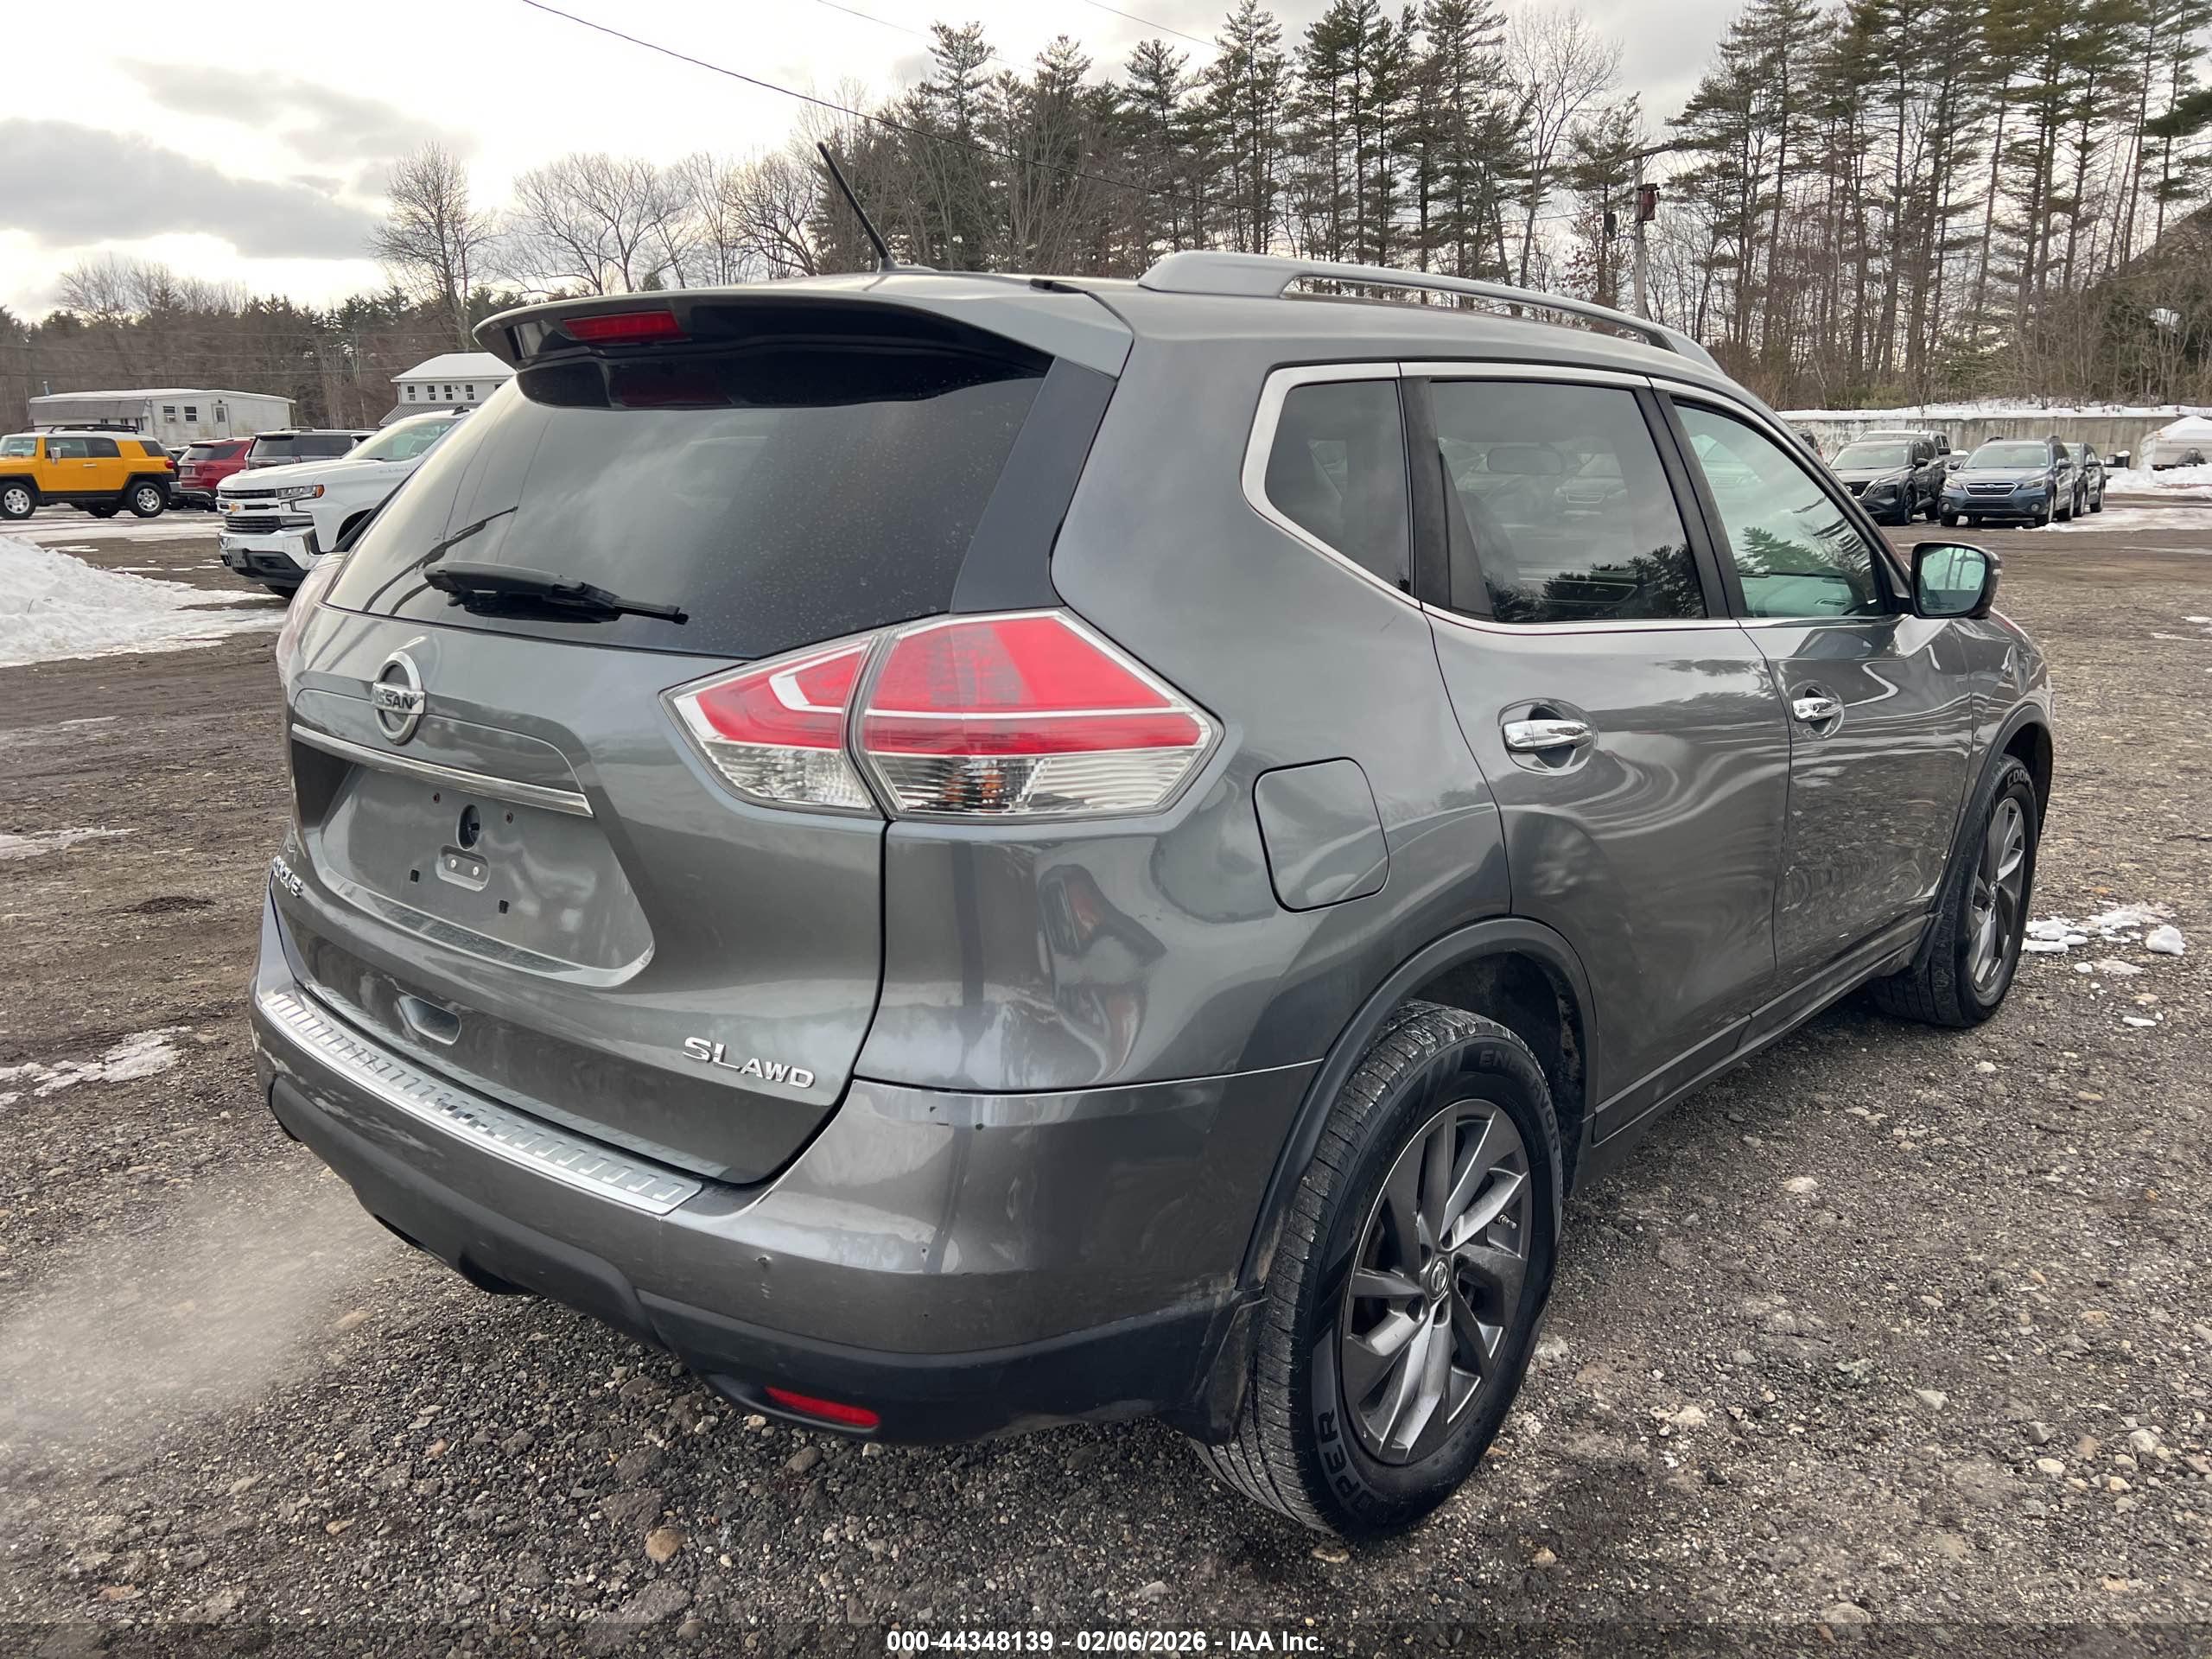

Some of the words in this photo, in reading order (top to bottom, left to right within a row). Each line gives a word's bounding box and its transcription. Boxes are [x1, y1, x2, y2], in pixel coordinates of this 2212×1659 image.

[373, 690, 415, 709] NISSAN
[683, 1037, 741, 1071] SL
[740, 1058, 815, 1089] AWD
